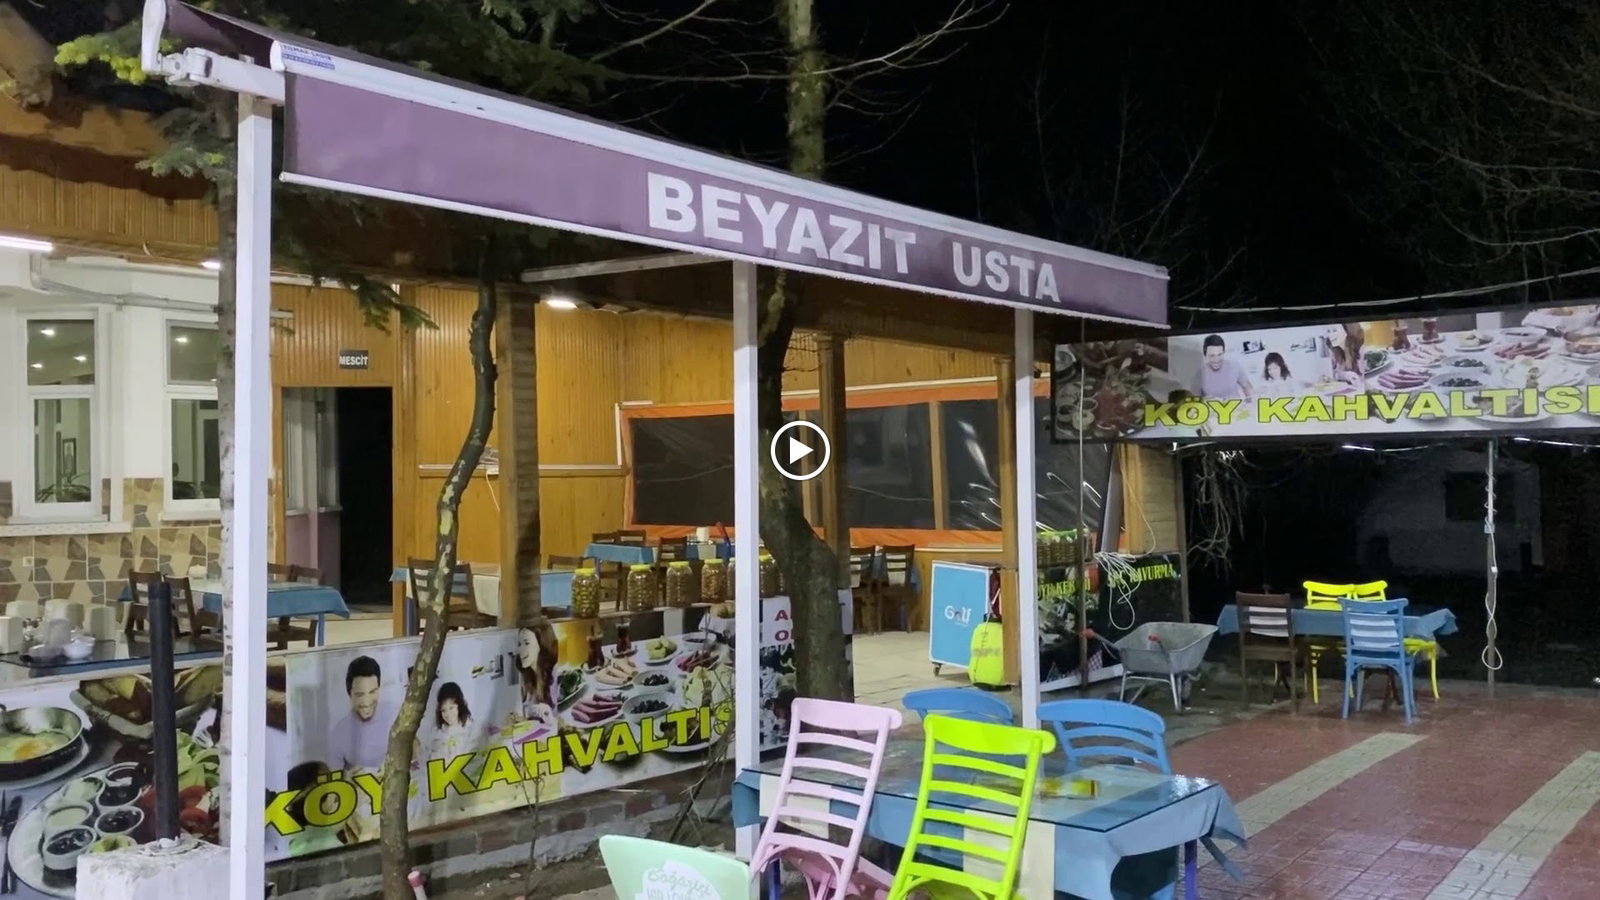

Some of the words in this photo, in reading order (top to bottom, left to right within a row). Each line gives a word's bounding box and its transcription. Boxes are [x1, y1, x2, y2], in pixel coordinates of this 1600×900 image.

[647, 171, 916, 275] BEYAZIT
[952, 242, 1062, 304] USTA
[1143, 397, 1242, 428] KÖY
